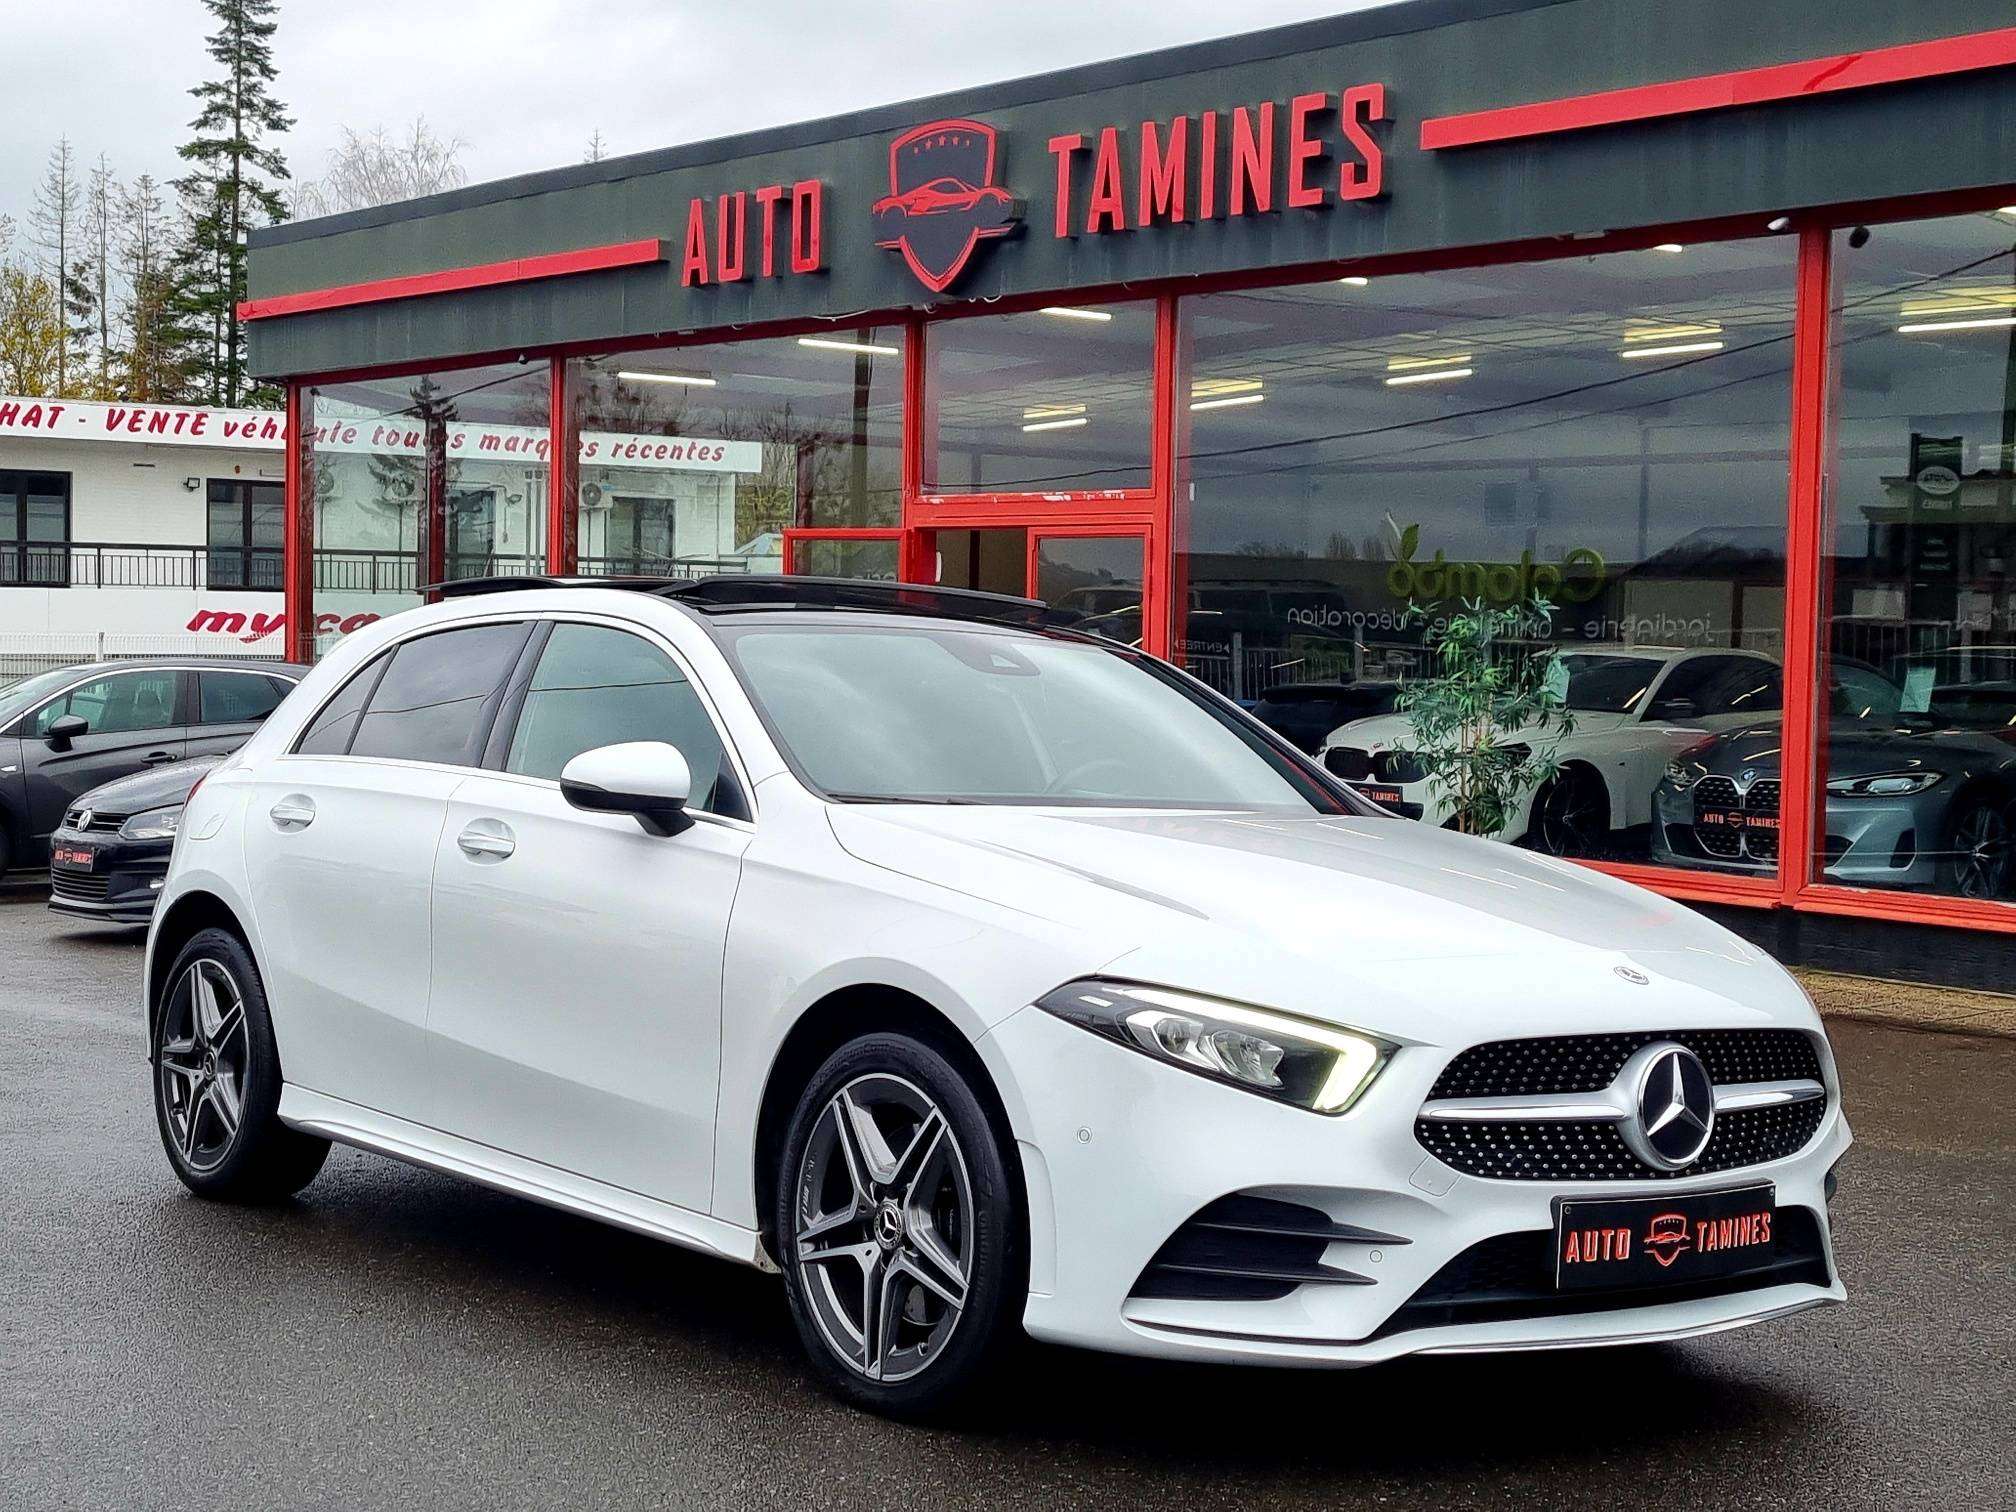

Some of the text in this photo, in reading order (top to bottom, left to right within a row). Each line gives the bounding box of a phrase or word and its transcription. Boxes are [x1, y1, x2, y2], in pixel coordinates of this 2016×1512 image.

[681, 82, 1389, 287] AUTO TAMINES
[106, 408, 209, 436] VENTE
[610, 437, 726, 463] récentes
[1565, 1211, 1772, 1264] AUTO TAMINES
